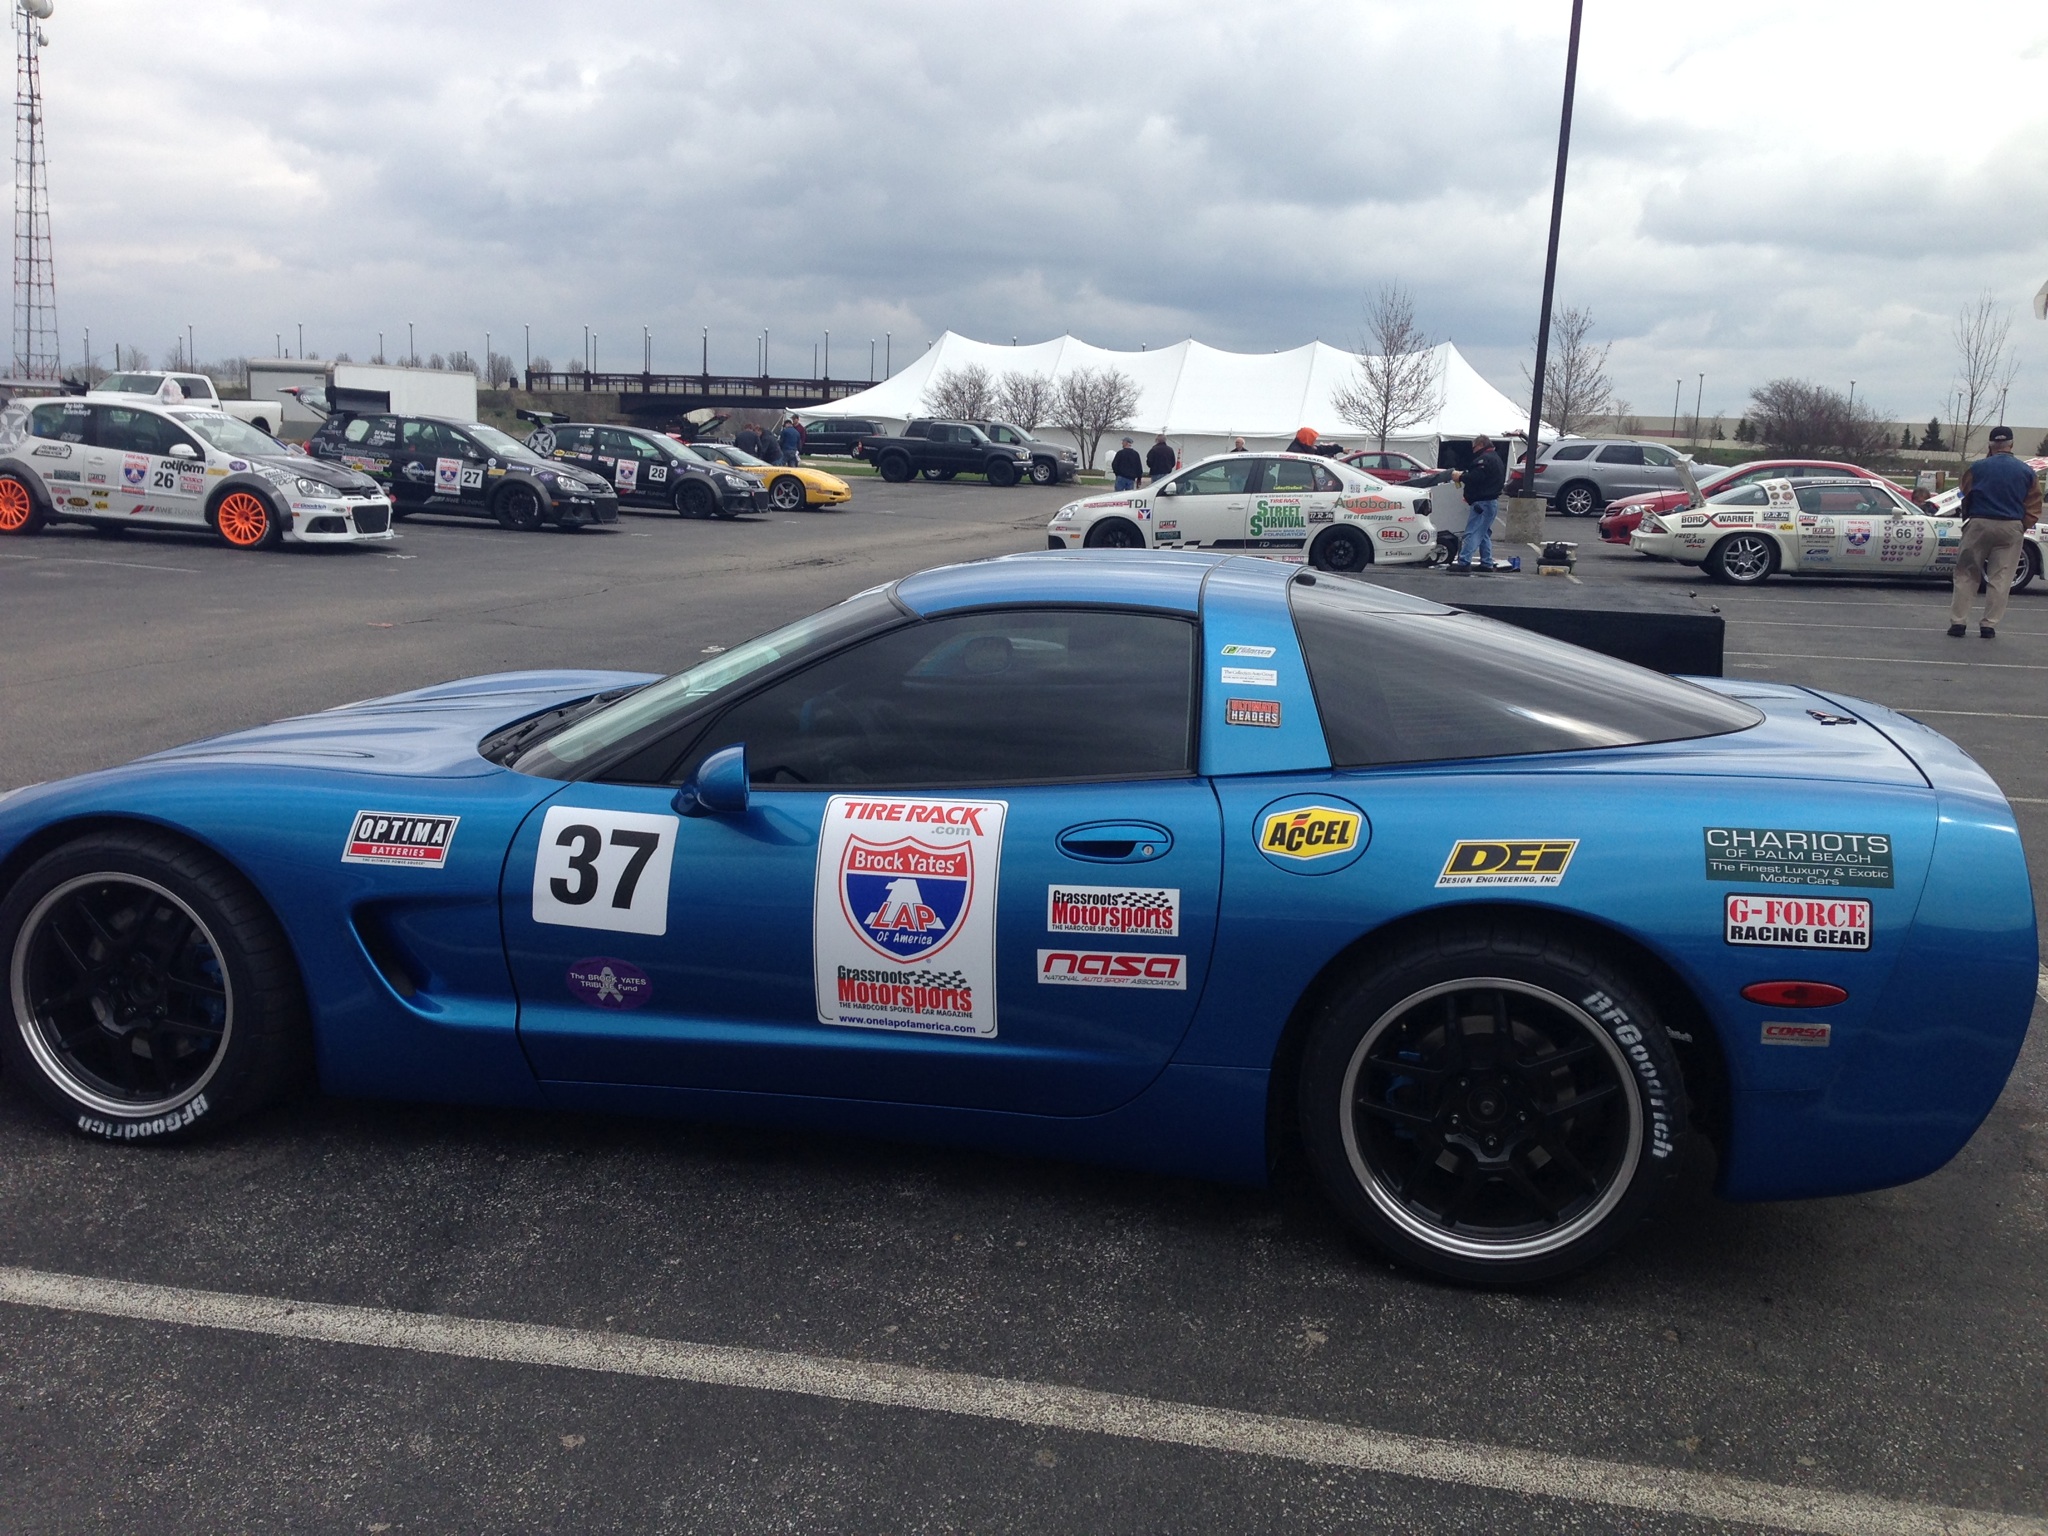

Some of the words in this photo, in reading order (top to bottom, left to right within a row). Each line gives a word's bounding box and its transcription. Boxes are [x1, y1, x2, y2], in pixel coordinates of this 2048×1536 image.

[160, 460, 204, 474] rotiform
[652, 468, 664, 479] 28
[154, 471, 174, 488] 26
[464, 471, 480, 484] 27
[1128, 499, 1147, 508] TDI
[1257, 500, 1300, 517] STREET
[1334, 498, 1402, 509] Autobarn
[1250, 515, 1306, 536] SURVIVAL
[1896, 528, 1912, 538] 66
[1231, 711, 1278, 723] HEADERS
[844, 802, 906, 821] TIRE
[905, 805, 984, 836] RACK
[359, 818, 446, 843] OPTIMA
[931, 825, 971, 836] .com
[1268, 820, 1350, 852] ACCEL
[1707, 829, 1889, 853] CHARIOTS
[371, 846, 424, 856] BATTERIES
[1725, 849, 1747, 858] OF
[1755, 850, 1804, 860] PALM
[1812, 852, 1871, 863] BEACH
[550, 824, 660, 909] 37
[855, 850, 903, 870] Brock
[908, 854, 961, 874] Yates'
[1710, 862, 1735, 871] The
[1740, 864, 1781, 873] Finest
[1785, 866, 1829, 876] Luxury
[1834, 868, 1844, 876] &
[1849, 869, 1888, 878] Exotic
[1439, 876, 1473, 884] DESIGN
[1475, 876, 1537, 884] ENGINEERING,
[1760, 874, 1802, 883] Motor
[1807, 876, 1840, 885] Cars
[1053, 890, 1118, 906] Grassroots
[870, 901, 936, 932] LAP
[1052, 901, 1173, 933] Motorsports
[1729, 899, 1865, 928] G-FORCE
[877, 931, 889, 942] Of
[893, 932, 933, 945] America
[1730, 926, 1808, 942] RACING
[1814, 929, 1866, 945] GEAR
[1043, 953, 1180, 978] nasa
[570, 972, 585, 980] The
[588, 974, 618, 983] BROCK
[621, 977, 646, 985] YATES
[838, 965, 910, 985] Grassroots
[1131, 978, 1180, 986] ASSOCIATION
[580, 981, 615, 990] TRIBUTE
[618, 984, 638, 992] Fund
[837, 978, 972, 1014] Motorsports
[853, 1003, 888, 1012] HARDCORE
[890, 1005, 914, 1014] SPORTS
[922, 1008, 935, 1016] CAR
[936, 1010, 973, 1018] MAGAZINE
[839, 1015, 976, 1033] www.onelapofamerica.com
[1766, 1026, 1827, 1038] CORSA
